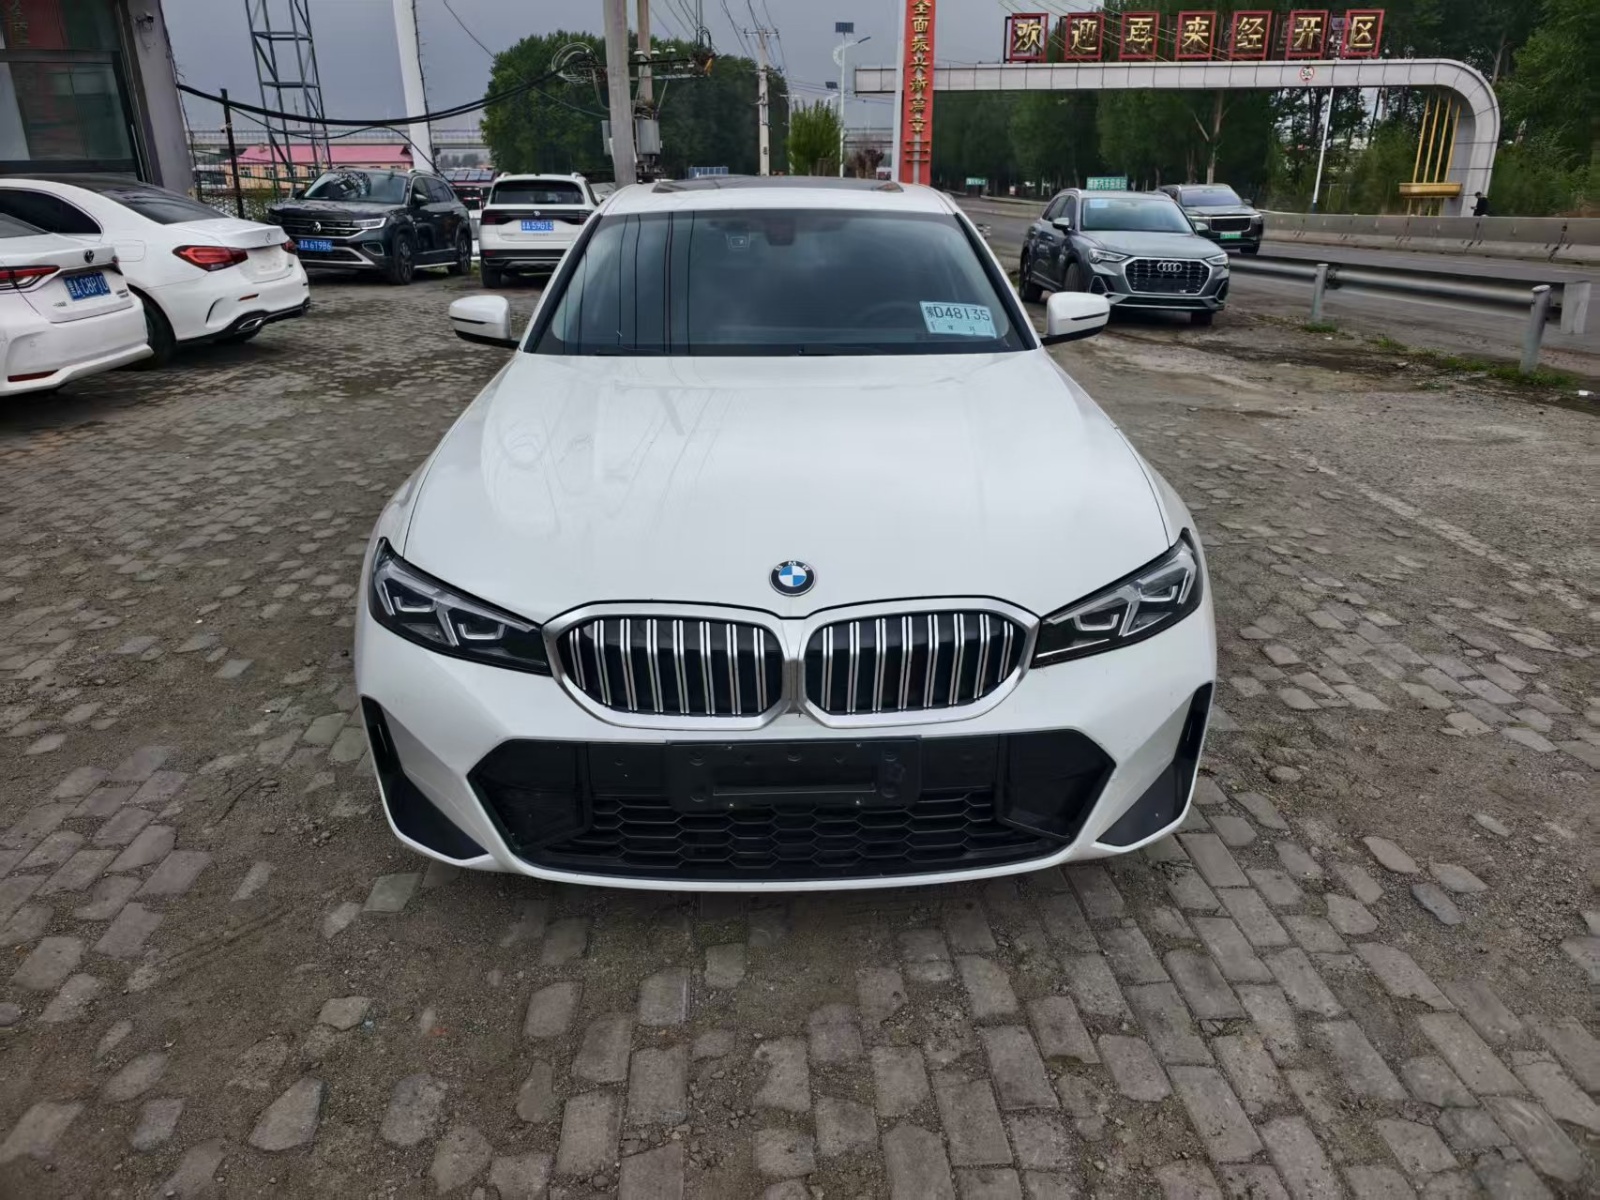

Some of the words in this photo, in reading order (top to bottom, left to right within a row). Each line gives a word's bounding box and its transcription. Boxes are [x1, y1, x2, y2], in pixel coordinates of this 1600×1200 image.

[1014, 15, 1376, 52] 欢迎再来经开区
